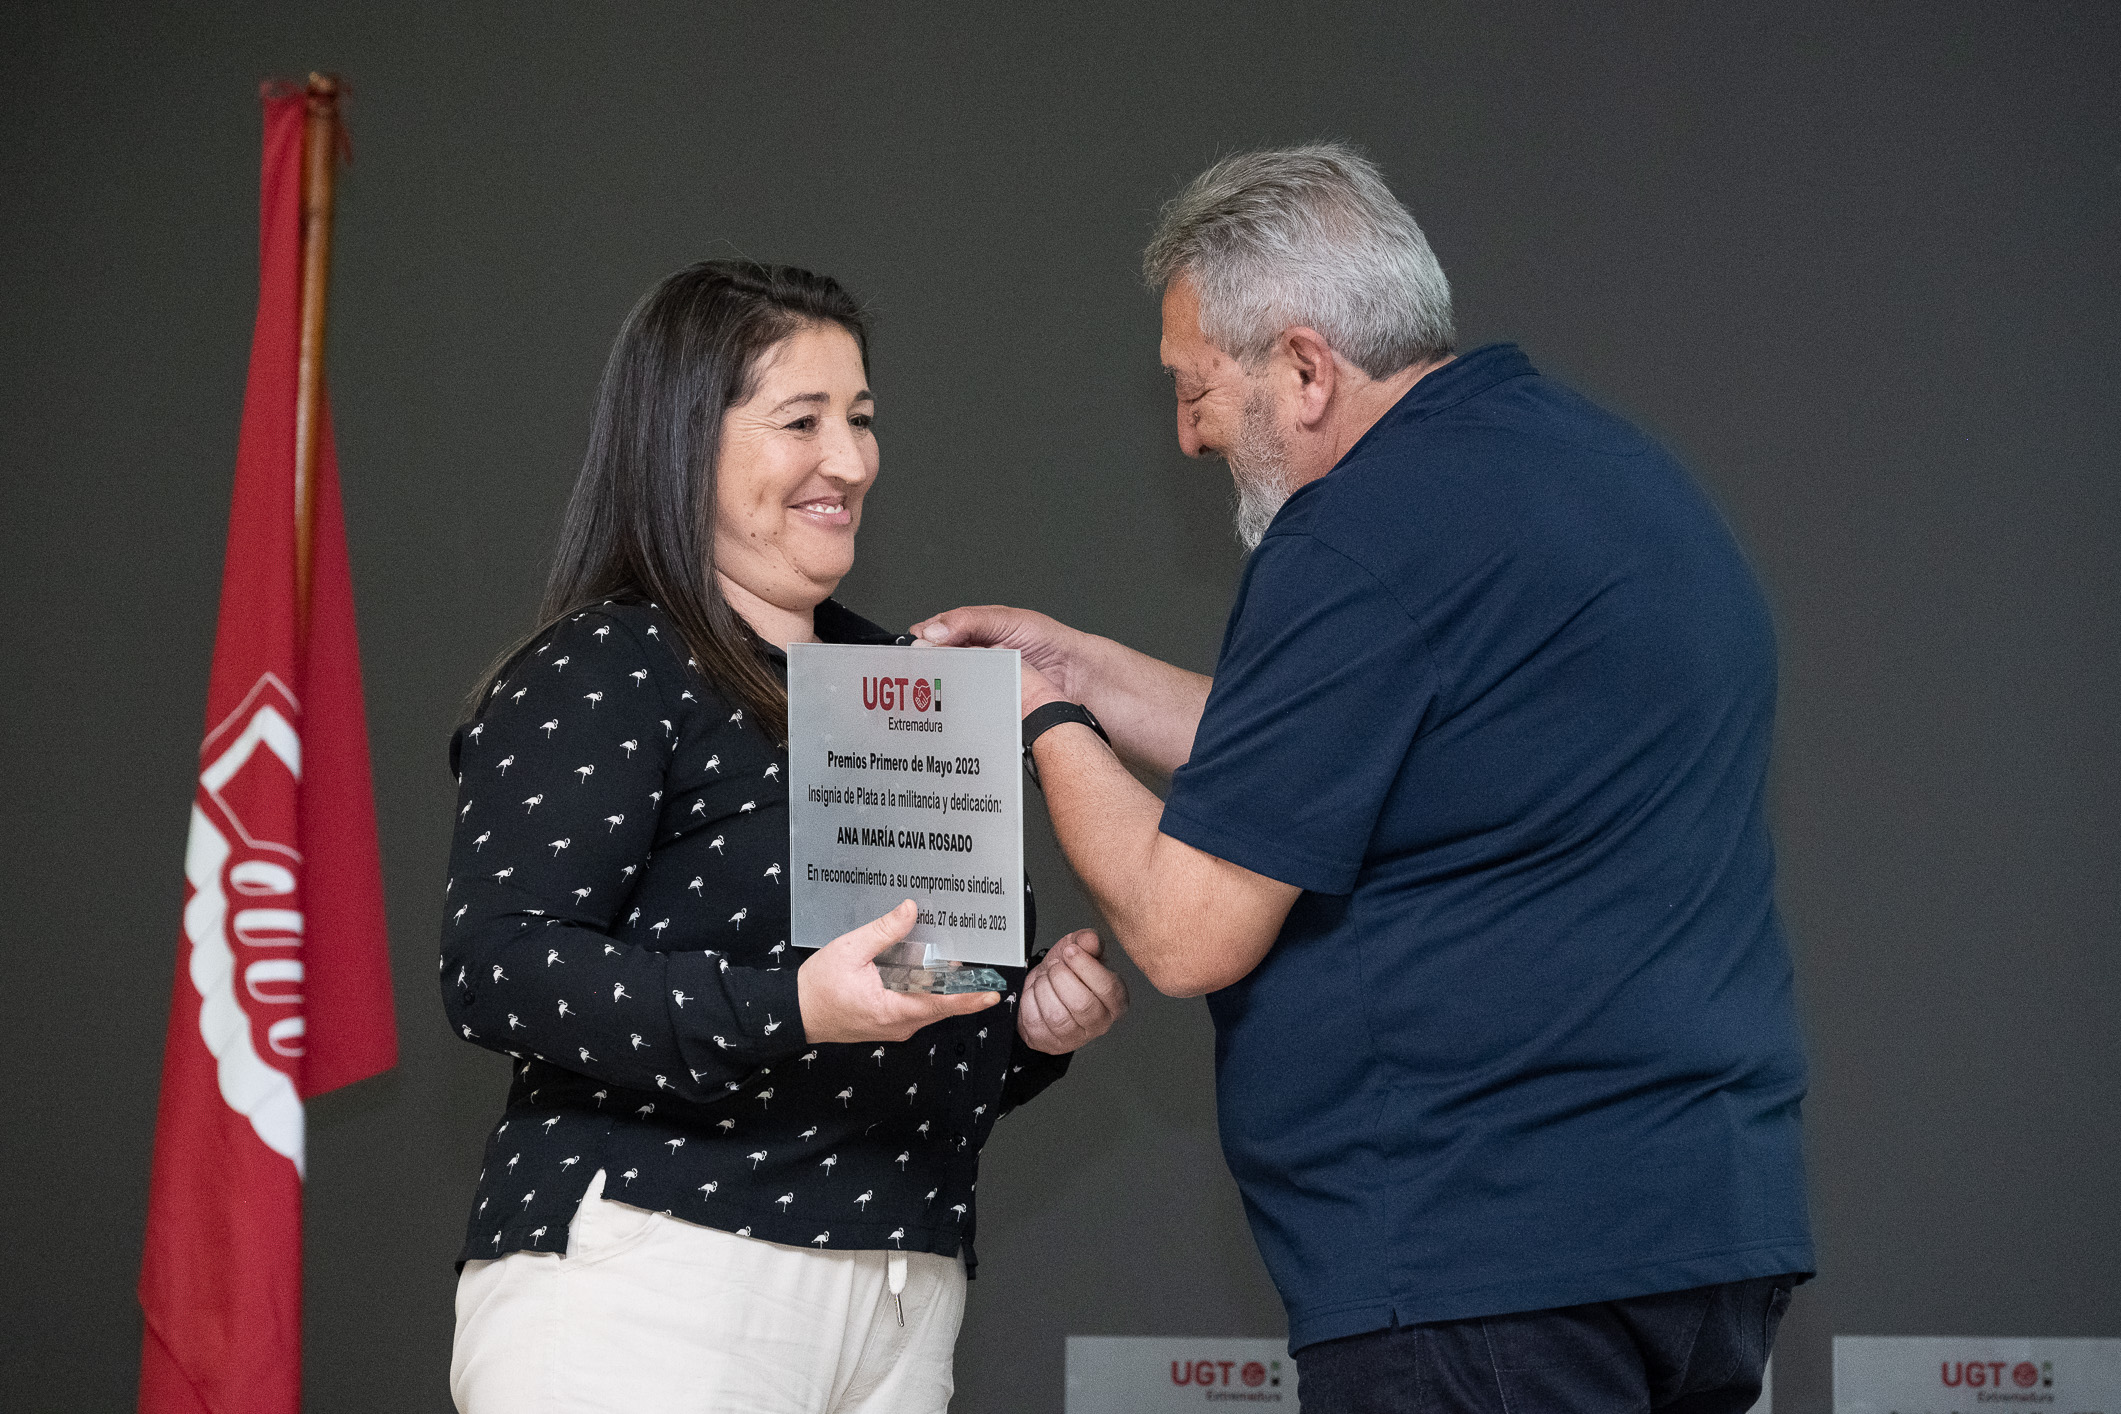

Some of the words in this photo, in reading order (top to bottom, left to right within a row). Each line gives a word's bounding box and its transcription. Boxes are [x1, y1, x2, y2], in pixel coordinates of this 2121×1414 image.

[863, 676, 909, 711] UGT
[888, 717, 943, 733] Extremadura
[827, 751, 867, 769] Premios
[870, 753, 908, 772] Primero
[911, 755, 923, 772] de
[926, 755, 953, 778] Mayo
[955, 757, 980, 776] 2023
[808, 784, 842, 807] Insignia
[844, 786, 855, 804] de
[857, 787, 879, 806] Plata
[880, 793, 886, 806] a
[888, 789, 896, 807] la
[898, 790, 941, 810] militancia
[942, 796, 948, 814] y
[950, 793, 1002, 813] dedicación:
[837, 826, 859, 845] ANA
[861, 825, 895, 848] MARÍA
[898, 830, 926, 850] CAVA
[929, 832, 973, 853] ROSADO
[807, 864, 819, 881] En
[821, 866, 887, 887] reconocimiento
[889, 873, 895, 887] a
[897, 873, 908, 888] su
[910, 874, 965, 894] compromiso
[967, 875, 1005, 896] sindical.
[916, 909, 937, 928] érida,
[938, 910, 947, 927] 27
[948, 912, 958, 928] de
[960, 913, 976, 929] abril
[978, 914, 987, 930] de
[989, 915, 1007, 931] 2023
[1171, 1361, 1235, 1386] UGT
[1941, 1361, 2006, 1388] UGT
